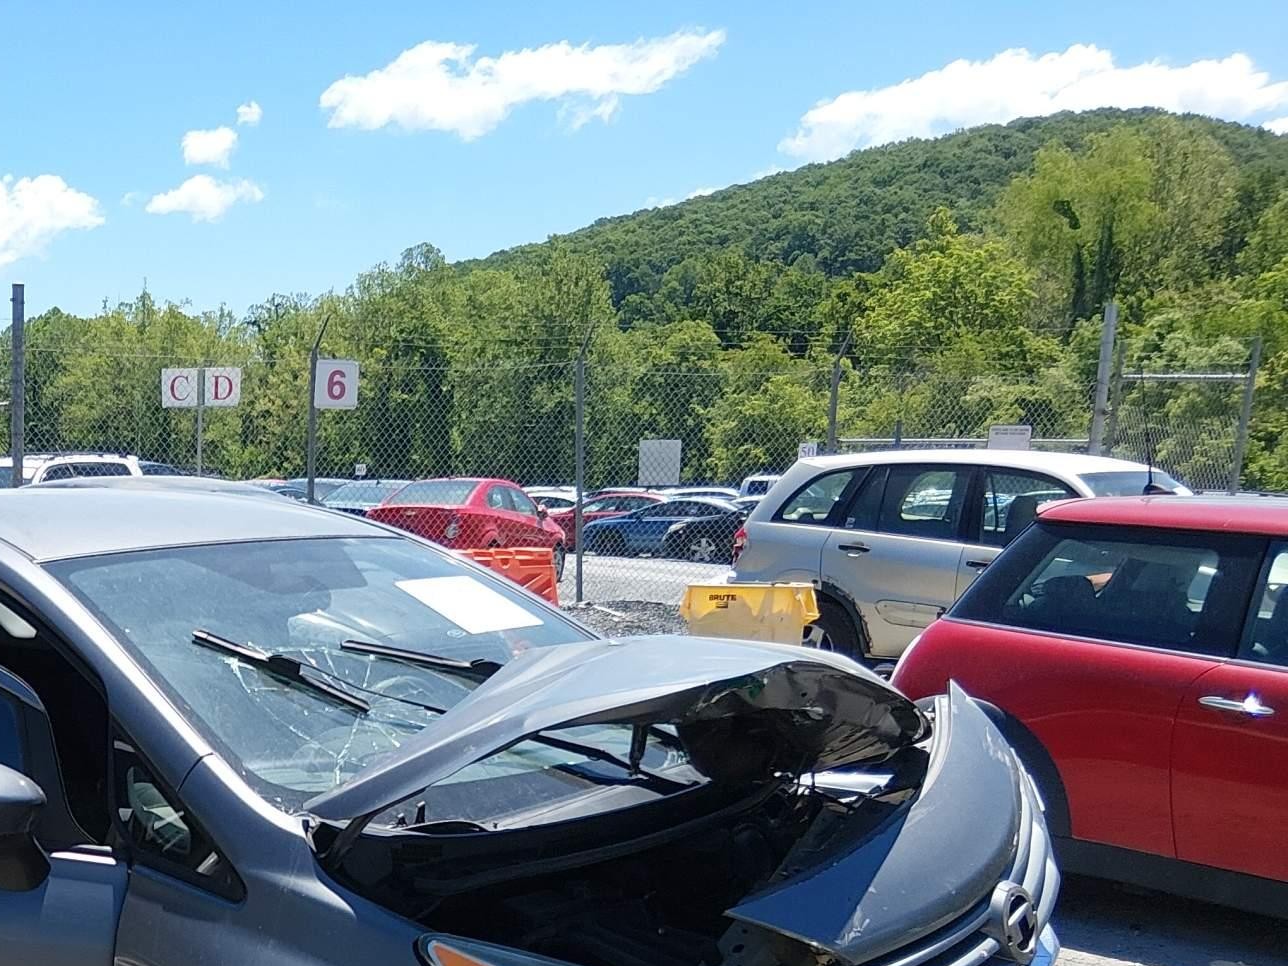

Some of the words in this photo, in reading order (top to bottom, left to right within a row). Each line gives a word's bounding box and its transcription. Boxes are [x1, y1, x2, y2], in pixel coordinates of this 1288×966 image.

[170, 375, 192, 401] C
[212, 375, 233, 401] D
[328, 370, 346, 400] 6
[708, 593, 737, 602] BRUTE
